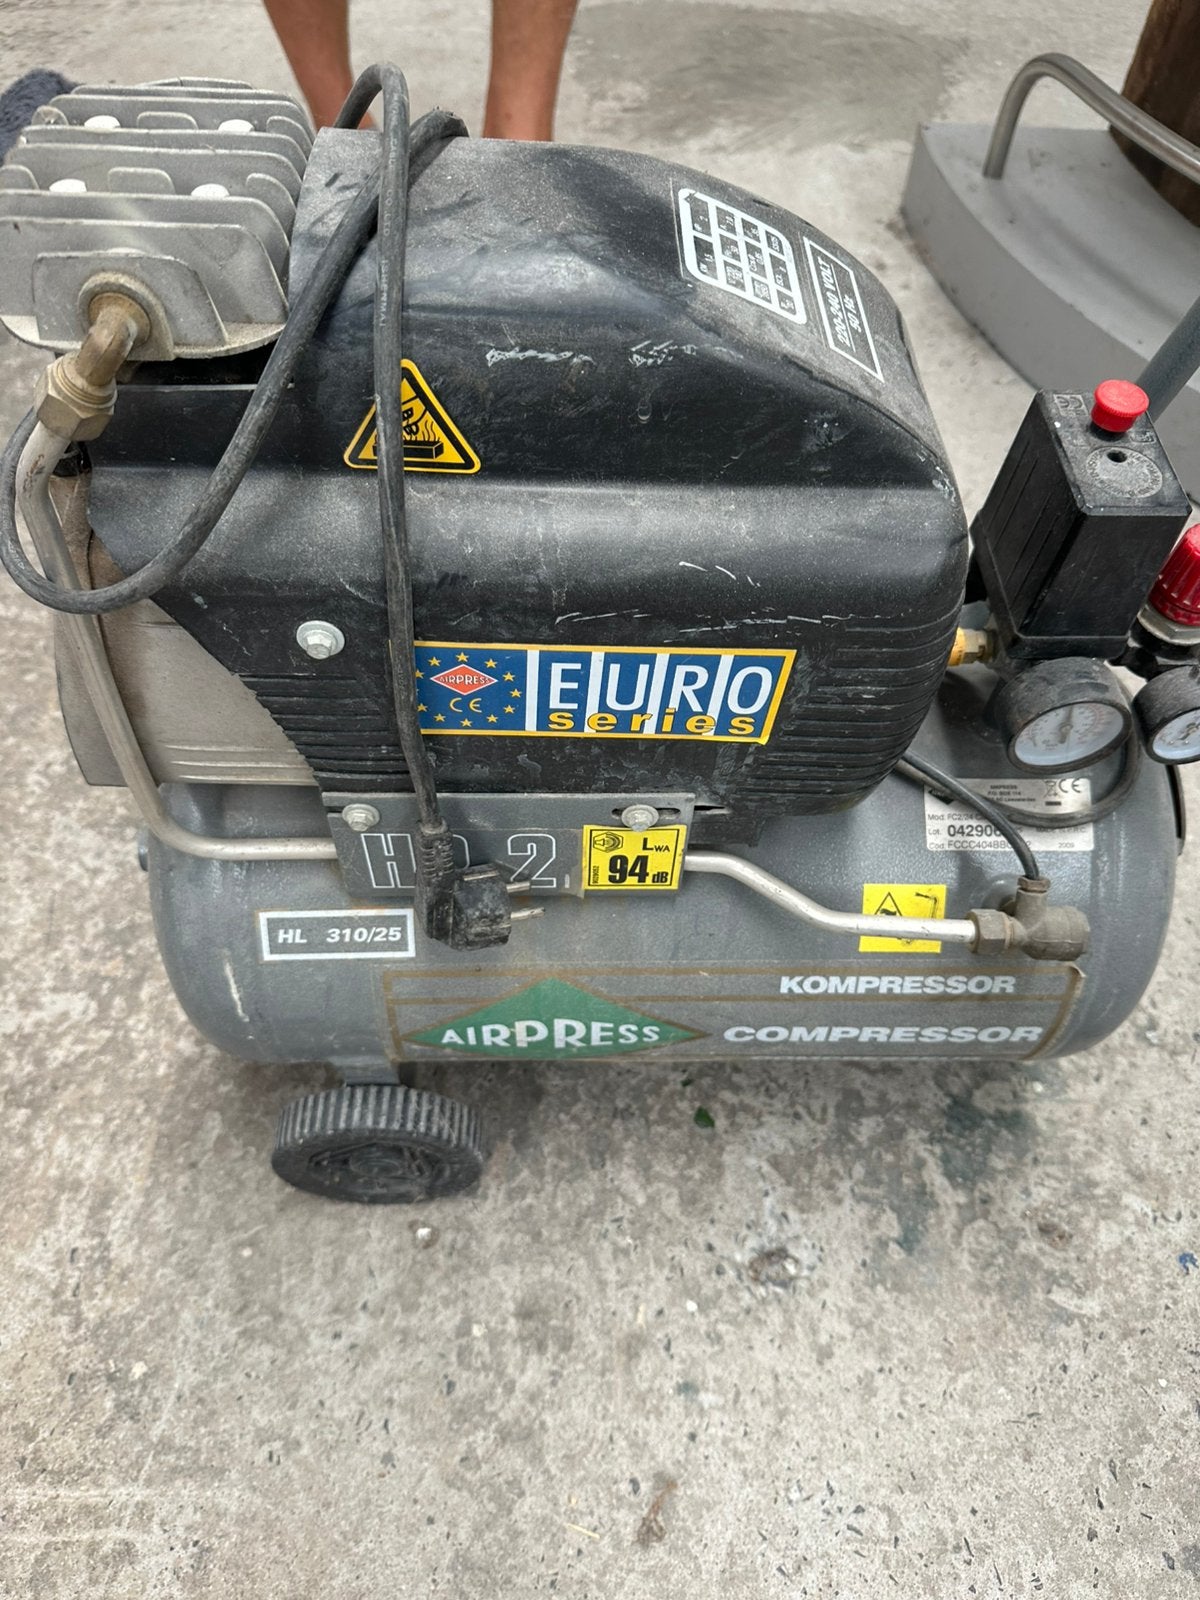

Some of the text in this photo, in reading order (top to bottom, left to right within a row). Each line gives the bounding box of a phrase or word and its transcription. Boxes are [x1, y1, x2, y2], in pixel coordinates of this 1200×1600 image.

[817, 256, 850, 347] 220-240 VOLT
[847, 312, 861, 333] 50
[439, 674, 491, 686] AIRPRESS
[549, 662, 772, 715] EURO
[548, 708, 756, 736] series
[608, 854, 669, 884] 94 dB
[277, 927, 402, 944] HL 310/25
[780, 975, 1016, 994] KOMPRESSOR
[441, 1018, 661, 1048] AIRPRESS
[723, 1025, 1044, 1043] COMPRESSOR
